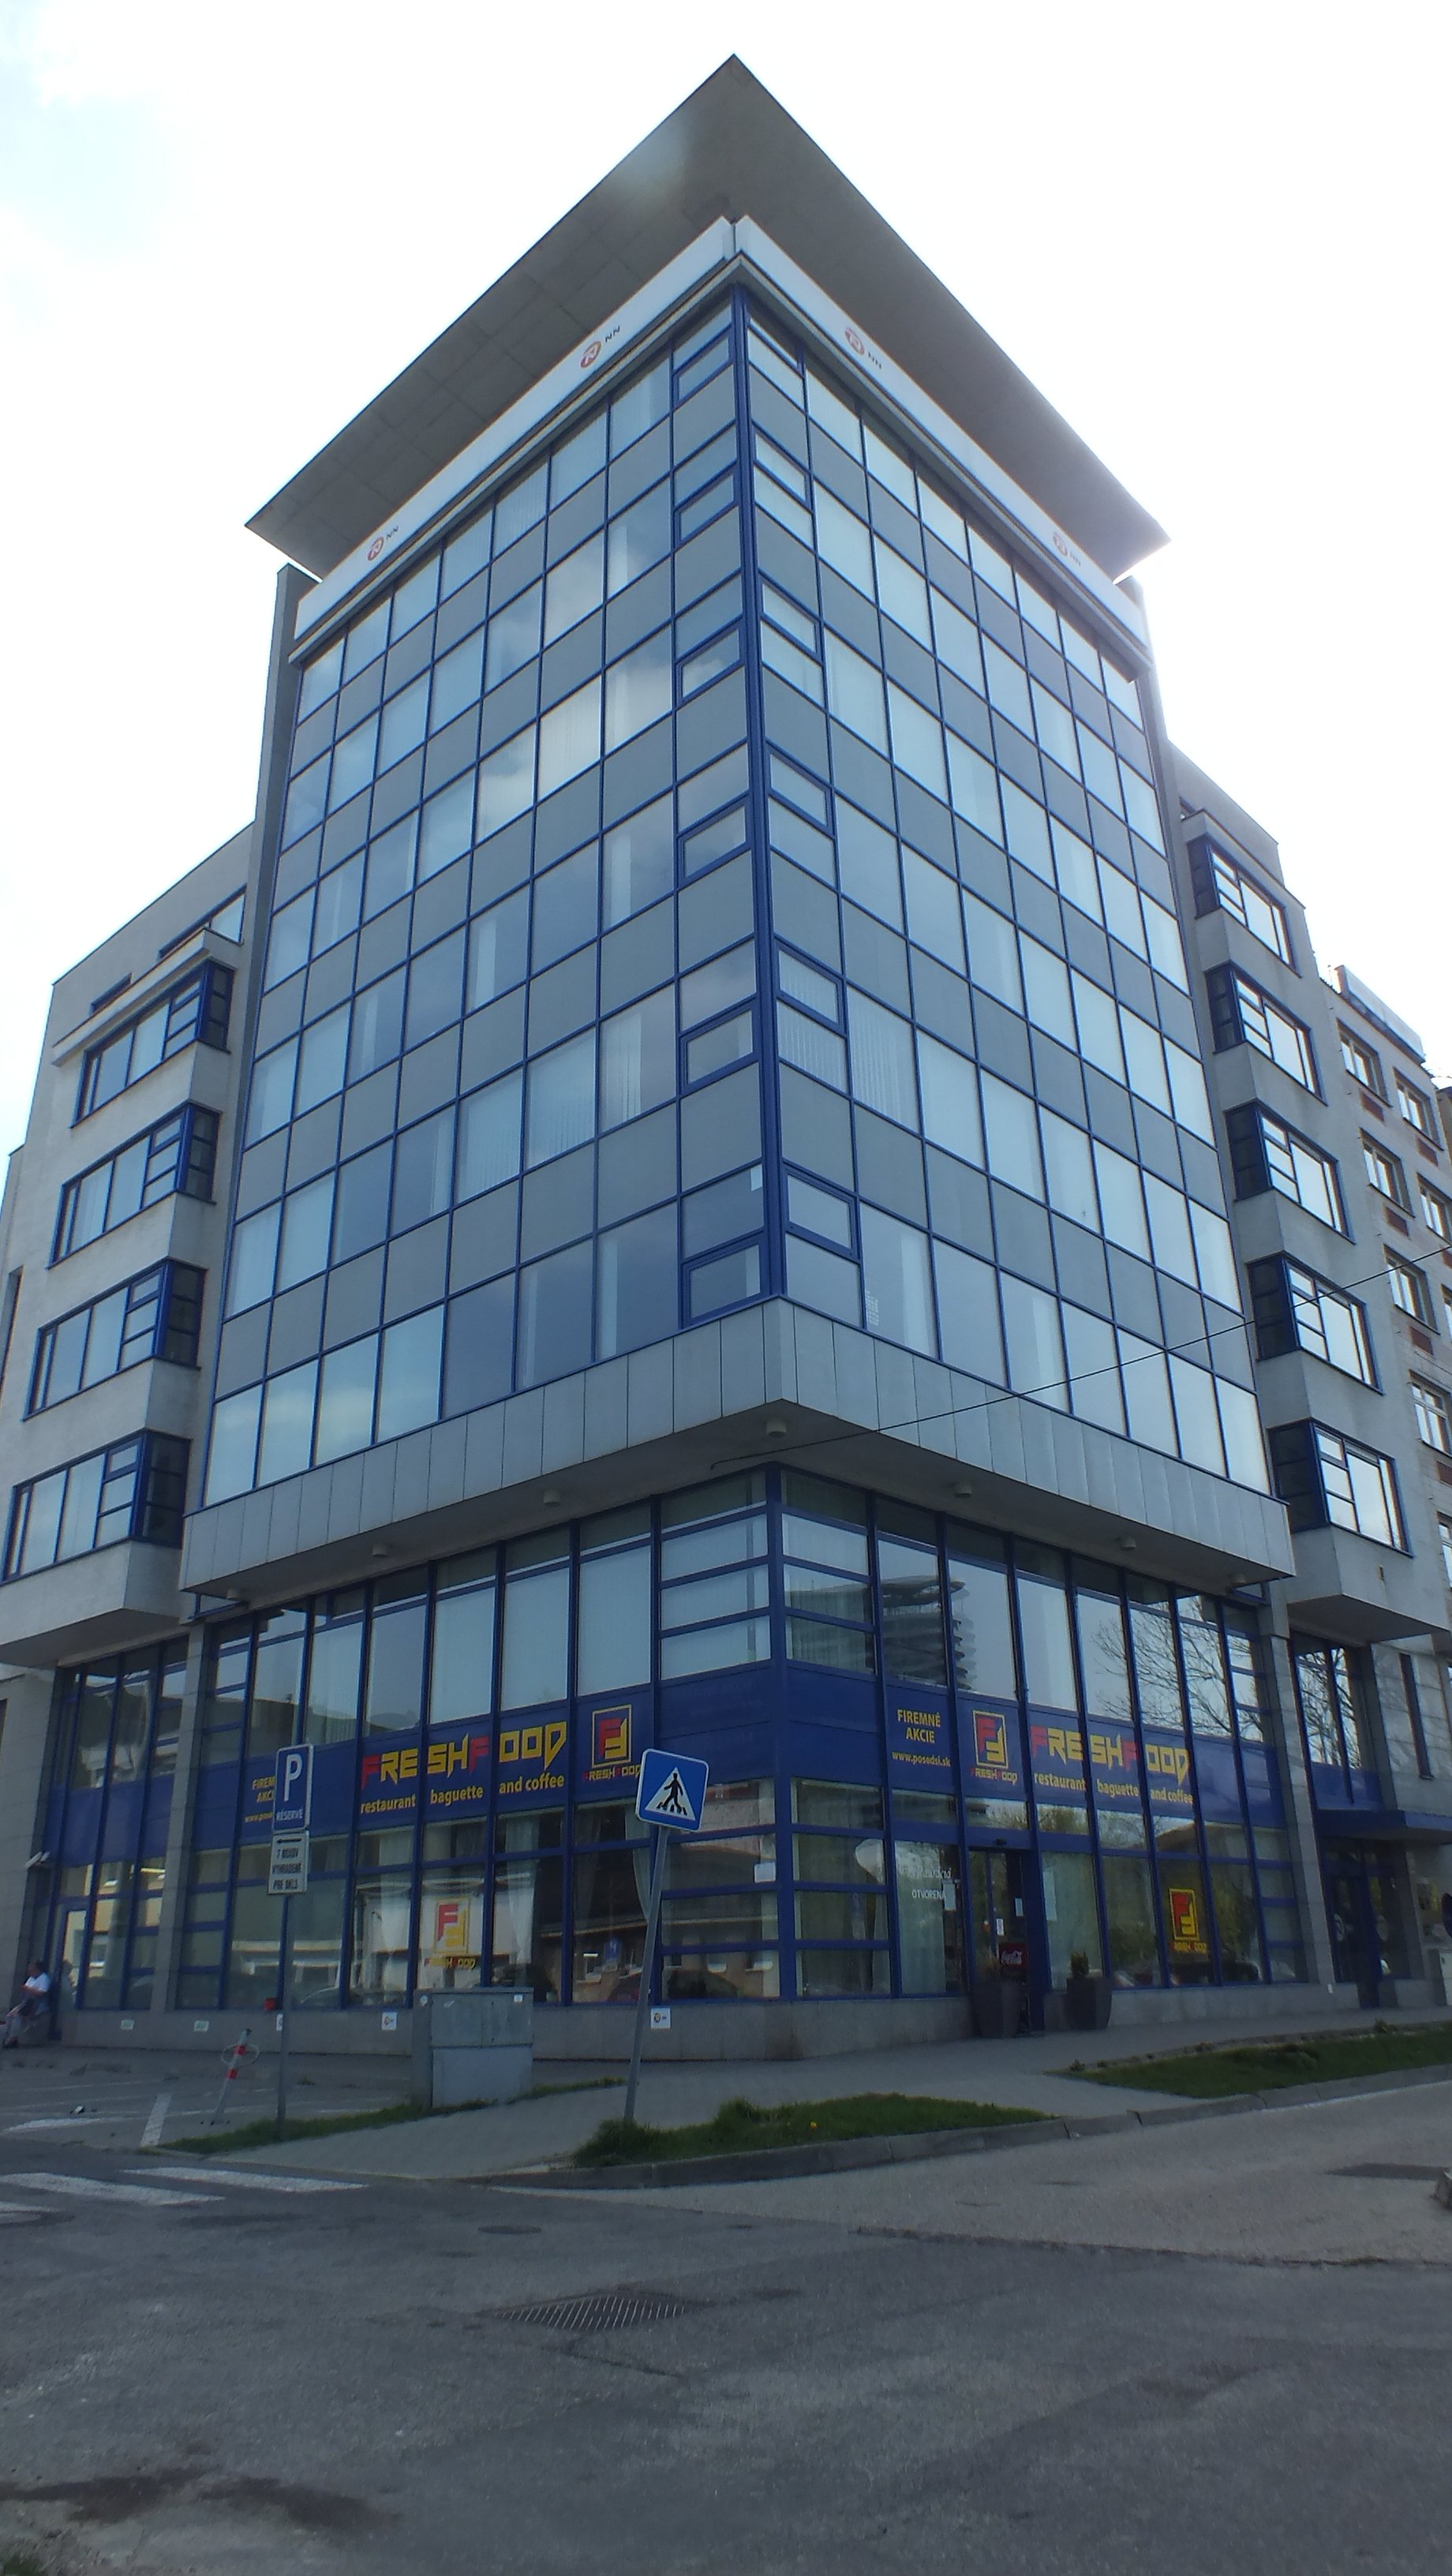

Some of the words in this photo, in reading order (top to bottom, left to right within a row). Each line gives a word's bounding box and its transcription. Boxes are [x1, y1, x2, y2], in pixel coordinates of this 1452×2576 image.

[605, 325, 620, 343] NN
[897, 1709, 941, 1728] FIREMNÉ
[906, 1728, 935, 1743] AKCIE
[284, 1754, 303, 1803] P
[1034, 1772, 1087, 1792] restaurant
[1097, 1779, 1139, 1798] baguette
[1150, 1787, 1166, 1801] and
[1167, 1789, 1194, 1805] coffee
[361, 1793, 417, 1814] restaurant
[429, 1784, 485, 1807] baguette
[499, 1777, 522, 1795] and
[526, 1773, 565, 1792] coffee
